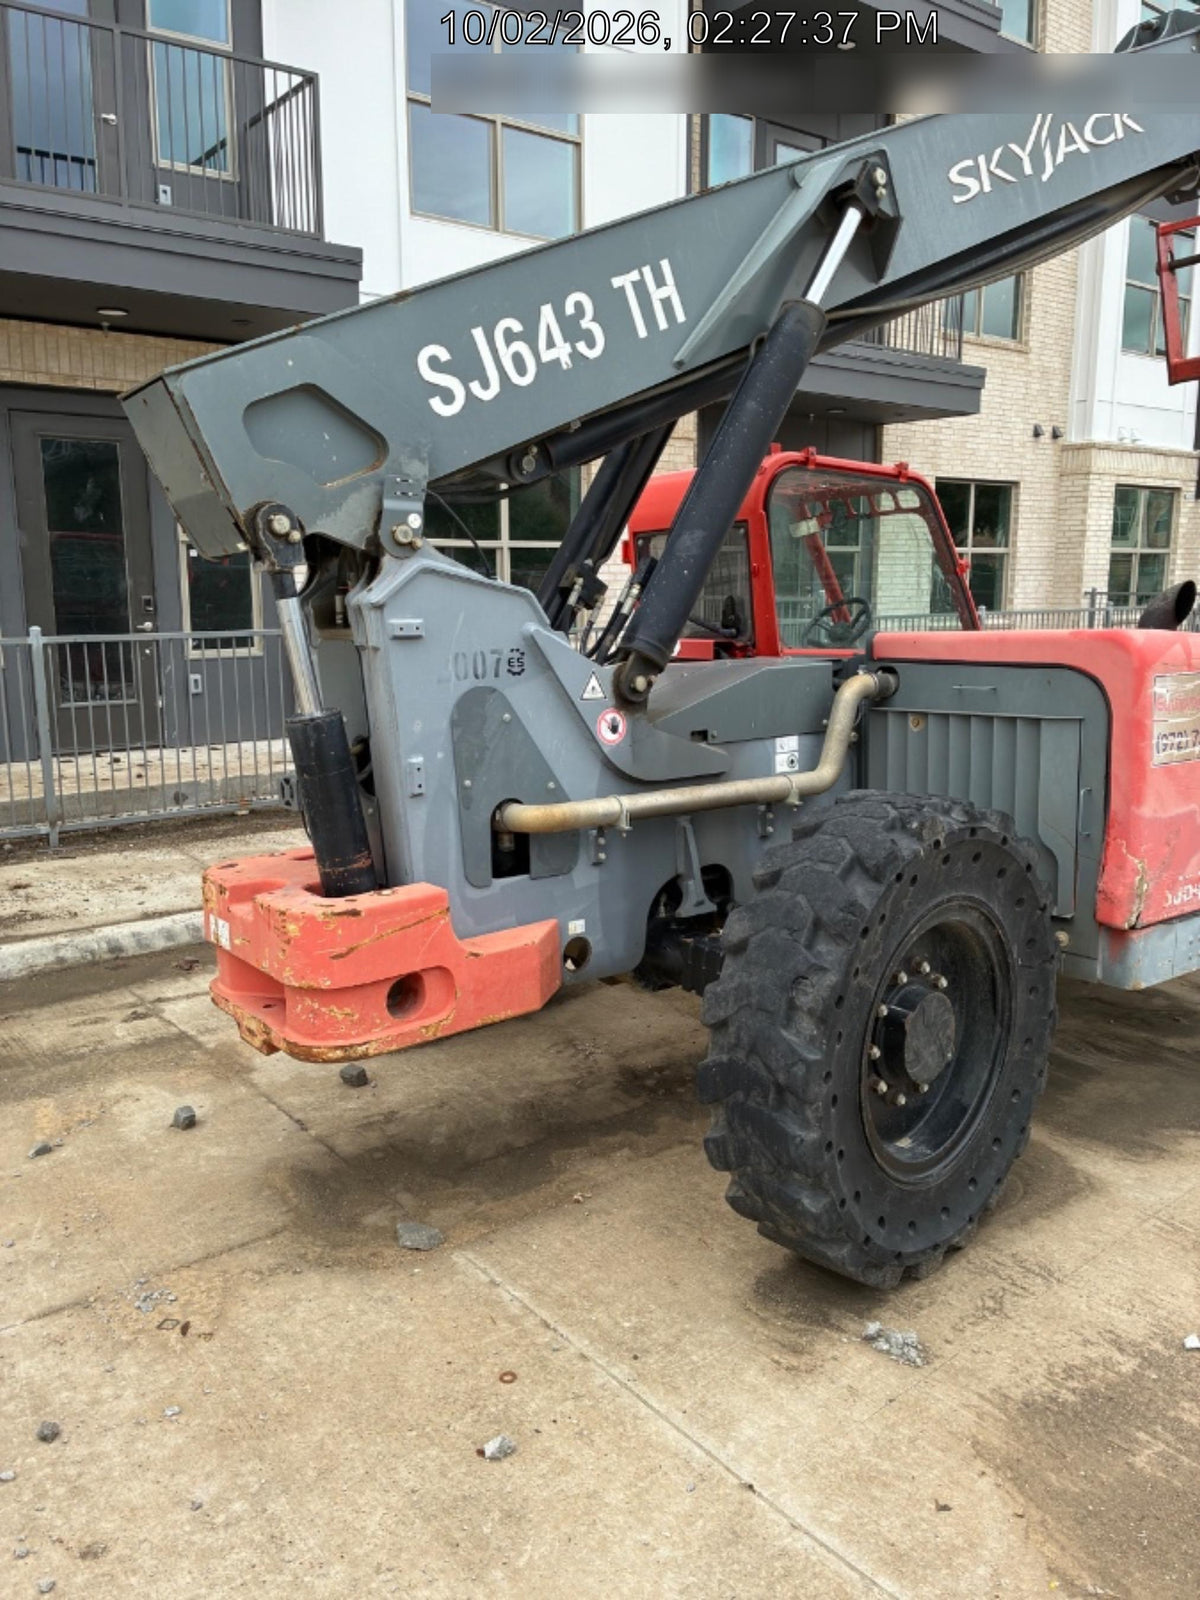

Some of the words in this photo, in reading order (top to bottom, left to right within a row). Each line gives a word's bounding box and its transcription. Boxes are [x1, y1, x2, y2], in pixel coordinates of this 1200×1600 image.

[948, 113, 1145, 203] SKYJACK
[417, 291, 606, 417] SJ643
[610, 258, 686, 338] TH
